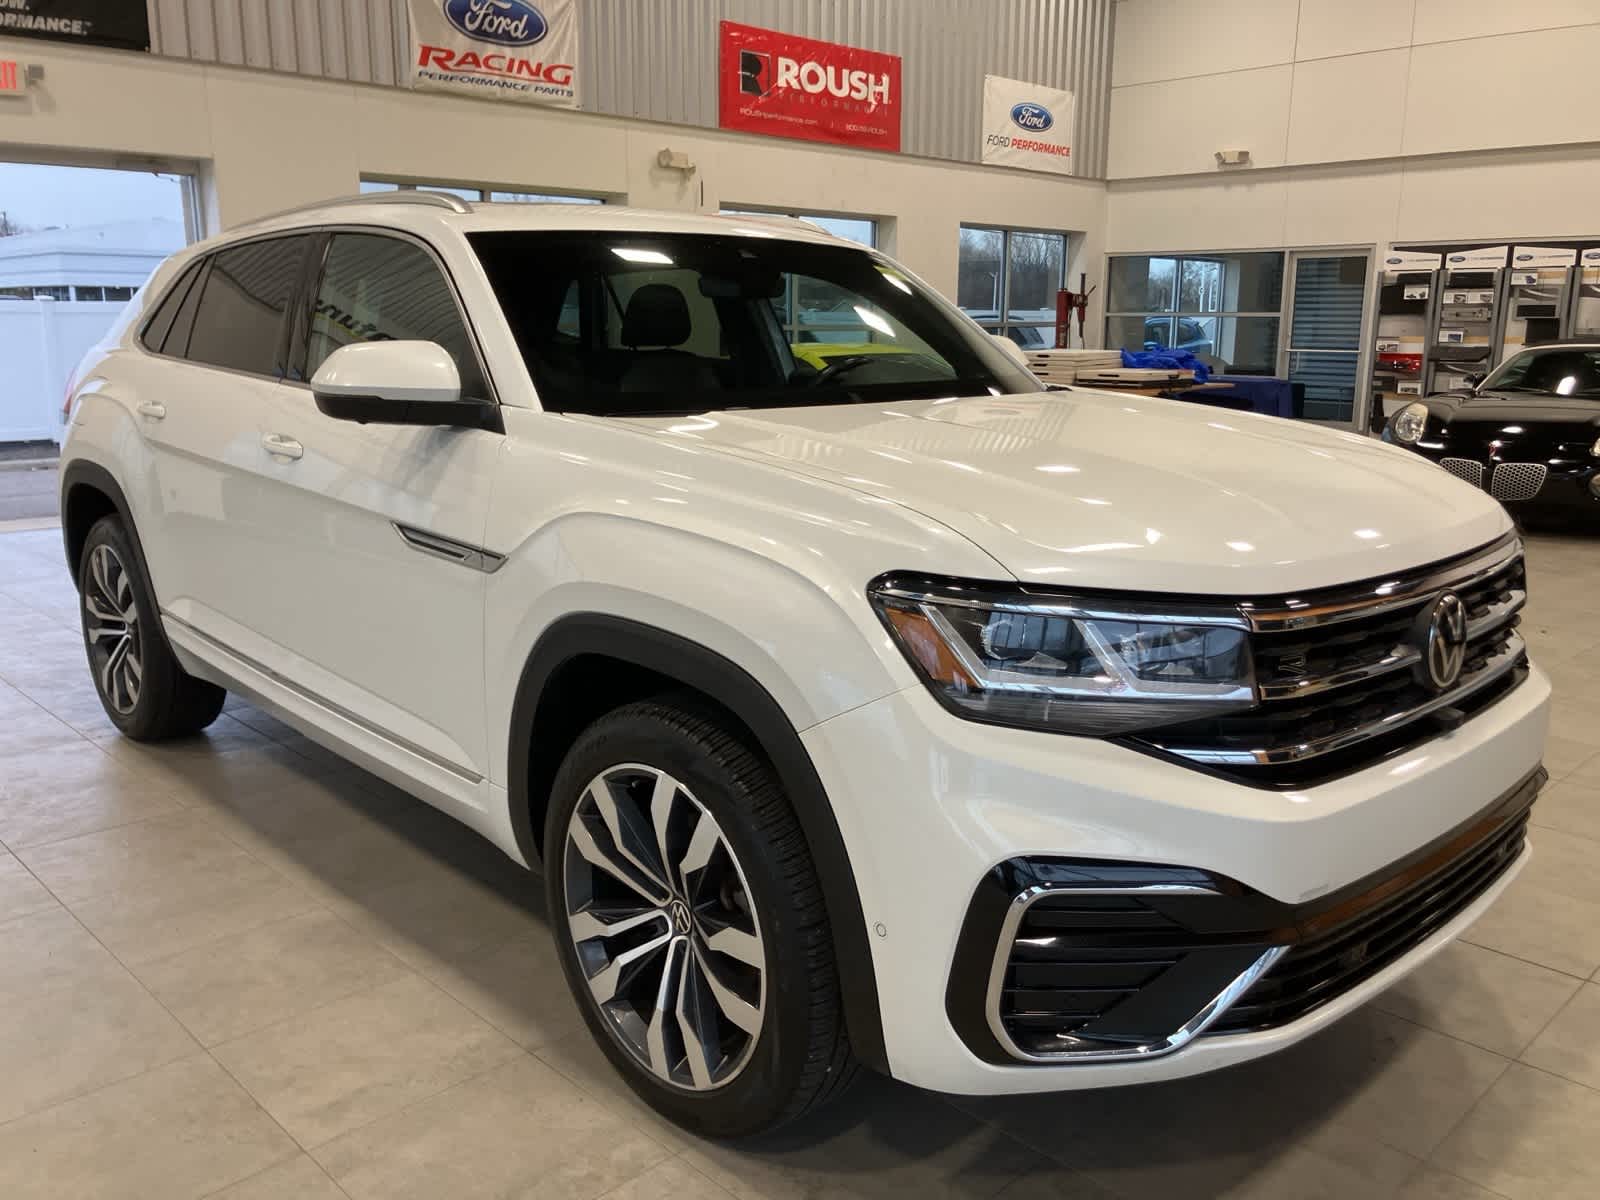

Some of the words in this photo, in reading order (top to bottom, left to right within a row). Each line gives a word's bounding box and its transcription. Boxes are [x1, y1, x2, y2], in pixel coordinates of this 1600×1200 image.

[465, 0, 529, 39] Ford
[418, 44, 574, 85] RACING
[777, 56, 892, 105] ROUSH
[418, 70, 530, 92] PERFORMANCE
[534, 85, 574, 97] PARTS
[1018, 106, 1046, 128] Ford
[986, 134, 1010, 148] FORD
[1011, 138, 1072, 157] PERFORMANCE
